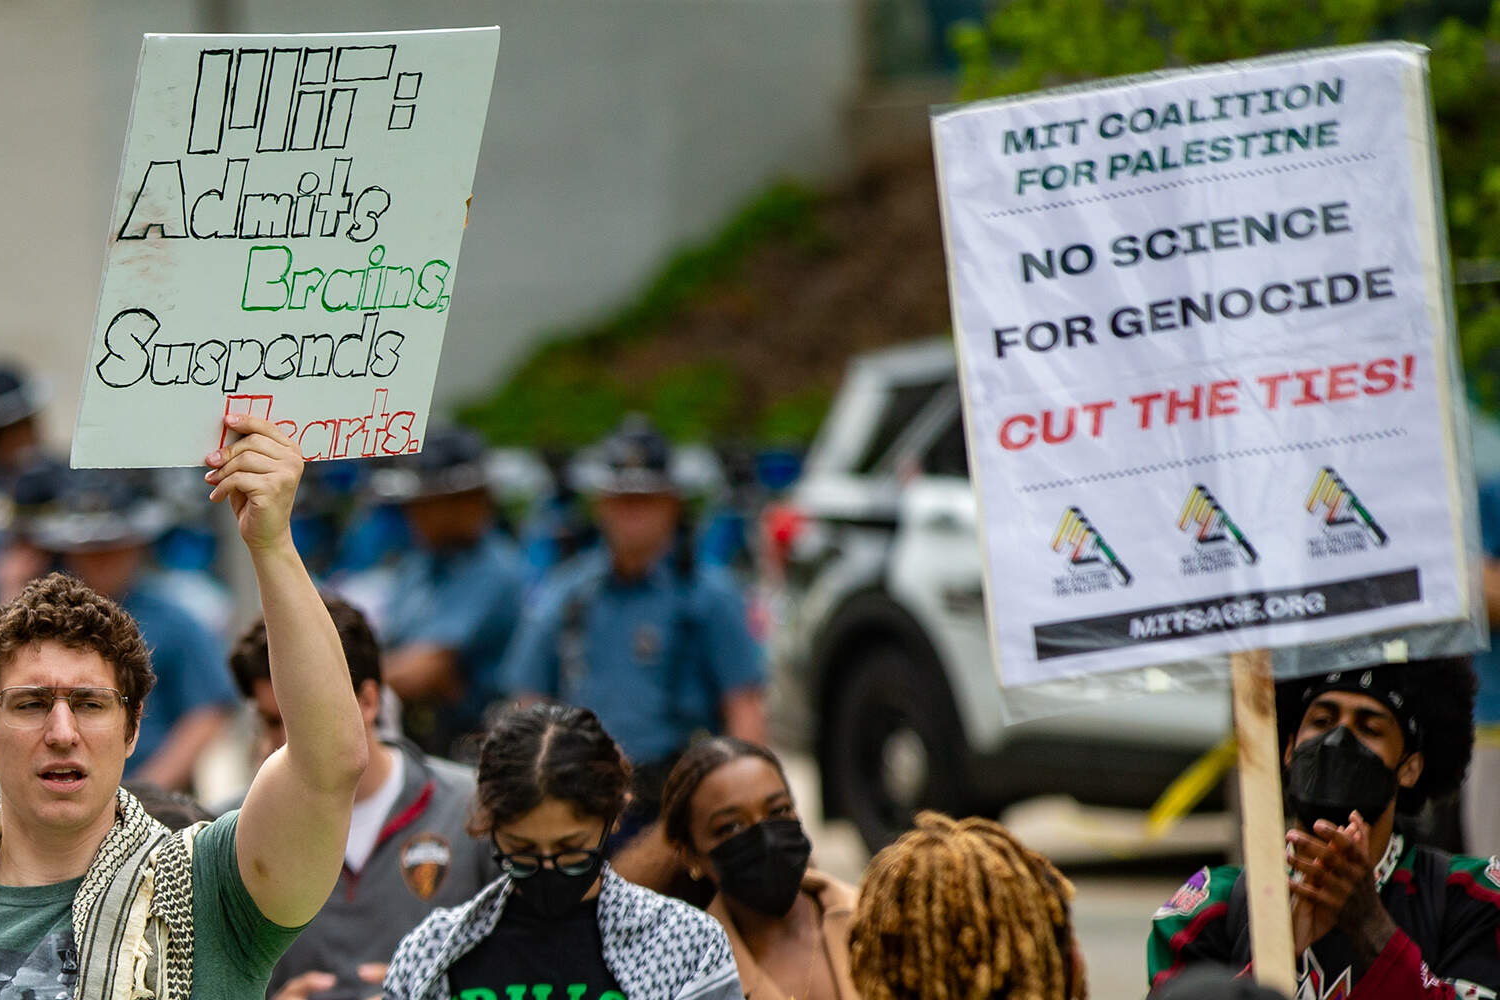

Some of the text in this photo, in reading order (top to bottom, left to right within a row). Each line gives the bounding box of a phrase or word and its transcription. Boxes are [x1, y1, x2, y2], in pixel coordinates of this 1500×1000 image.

[1002, 77, 1347, 155] MIT COALITION
[1015, 120, 1342, 196] FOR PALESTINE
[116, 158, 391, 242] Admits
[1020, 200, 1354, 283] NO SCIENCE
[241, 245, 451, 313] Brains,
[993, 266, 1398, 358] FOR GENOCIDE
[96, 307, 405, 392] Suspends
[997, 353, 1418, 452] CUT THE TIES!
[1127, 592, 1327, 639] MITSAGE.ORG
